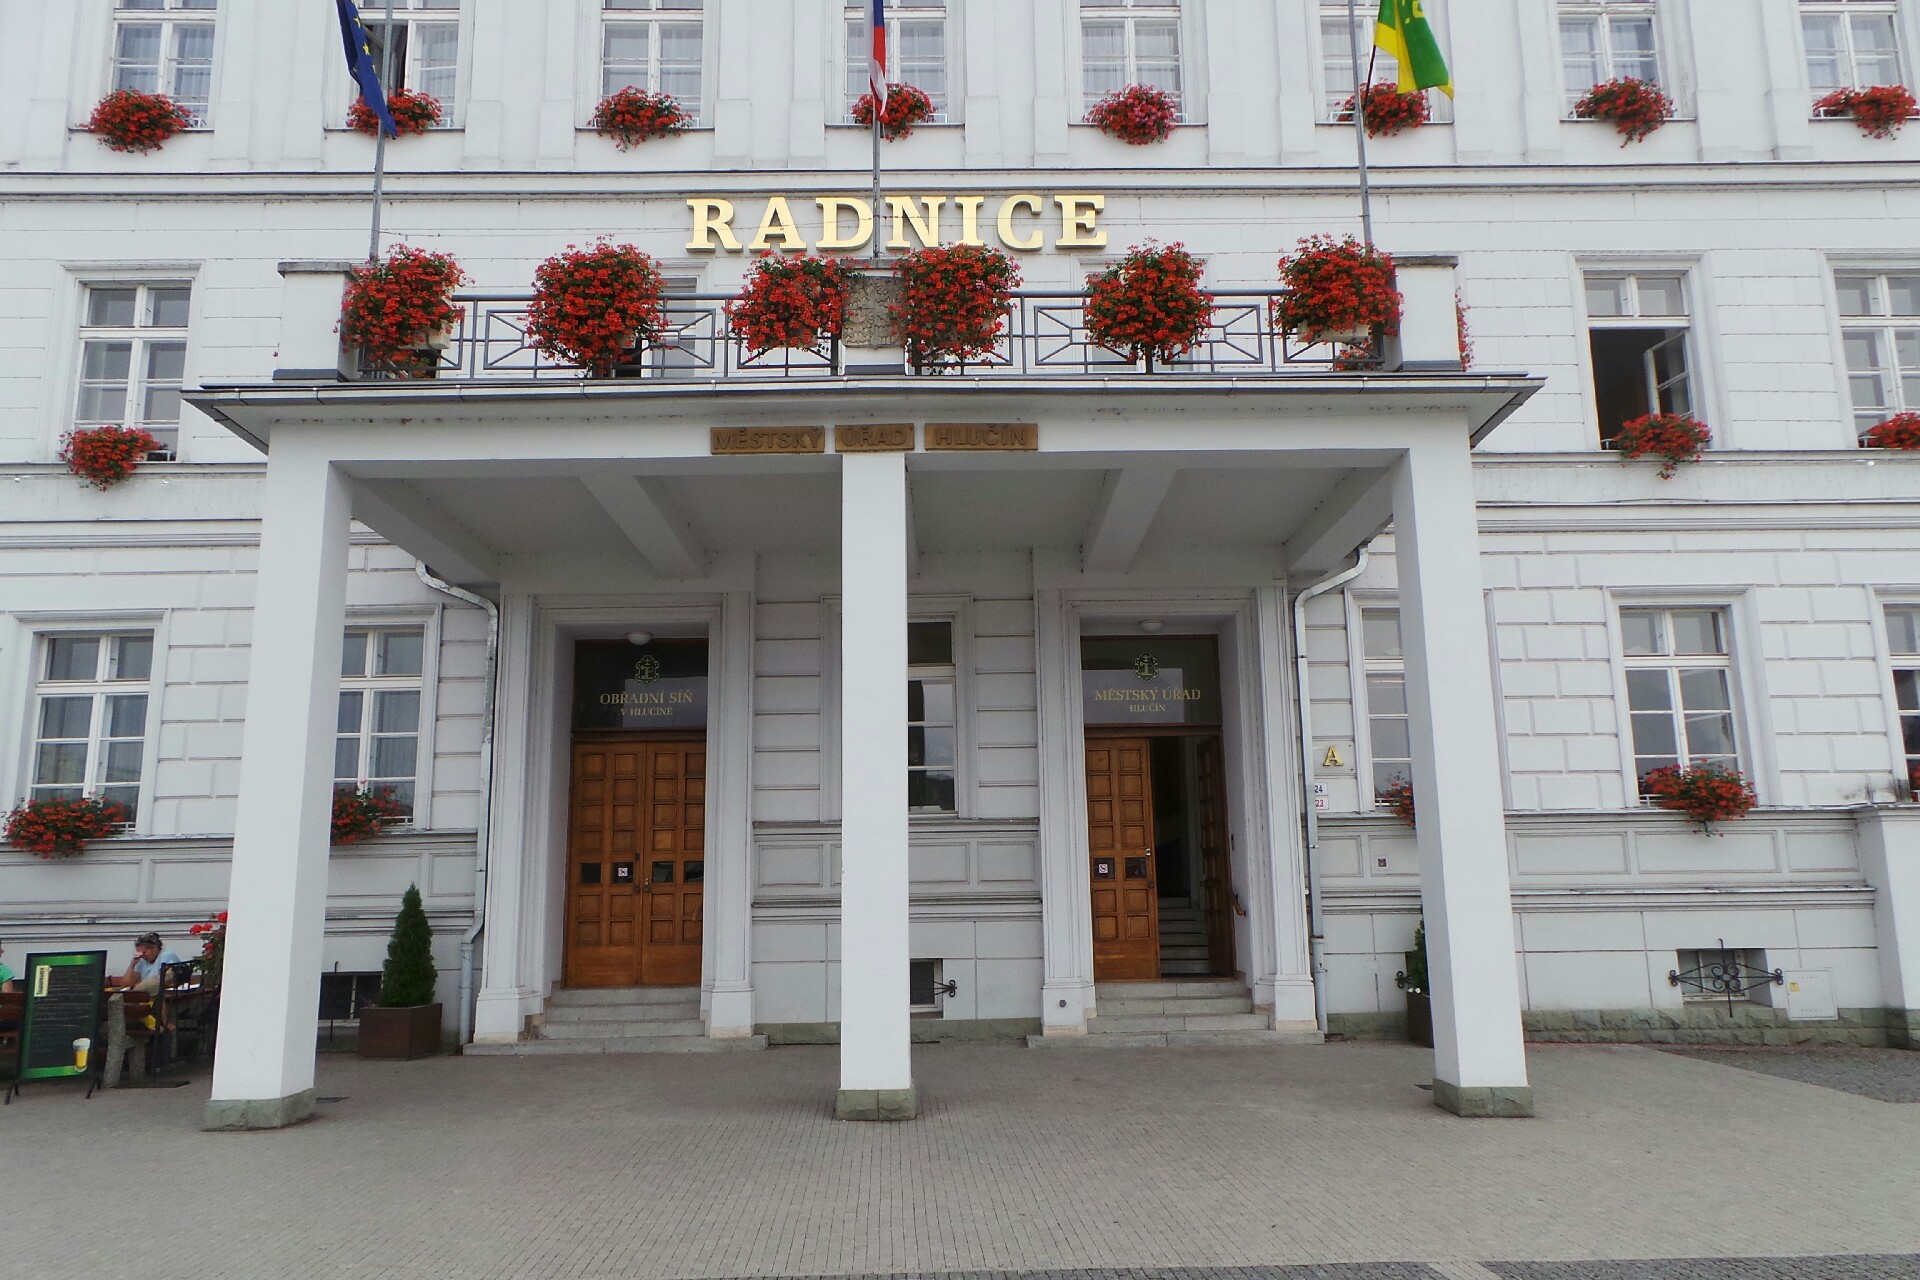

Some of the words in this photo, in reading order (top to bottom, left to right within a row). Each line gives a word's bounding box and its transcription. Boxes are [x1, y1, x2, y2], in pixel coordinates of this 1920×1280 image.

[685, 194, 1107, 252] RADNICE
[713, 427, 822, 449] MĚSTSKÝ
[842, 426, 906, 446] ÚŘAD
[935, 424, 1027, 445] HLUČÍN
[600, 690, 664, 705] OBŘADNÍ
[669, 689, 693, 704] SÍŇ
[1095, 687, 1158, 701] MĚSTSKÝ
[1163, 687, 1201, 700] ÚŘAD
[1129, 702, 1166, 713] HLUČÍN
[1323, 746, 1344, 767] A
